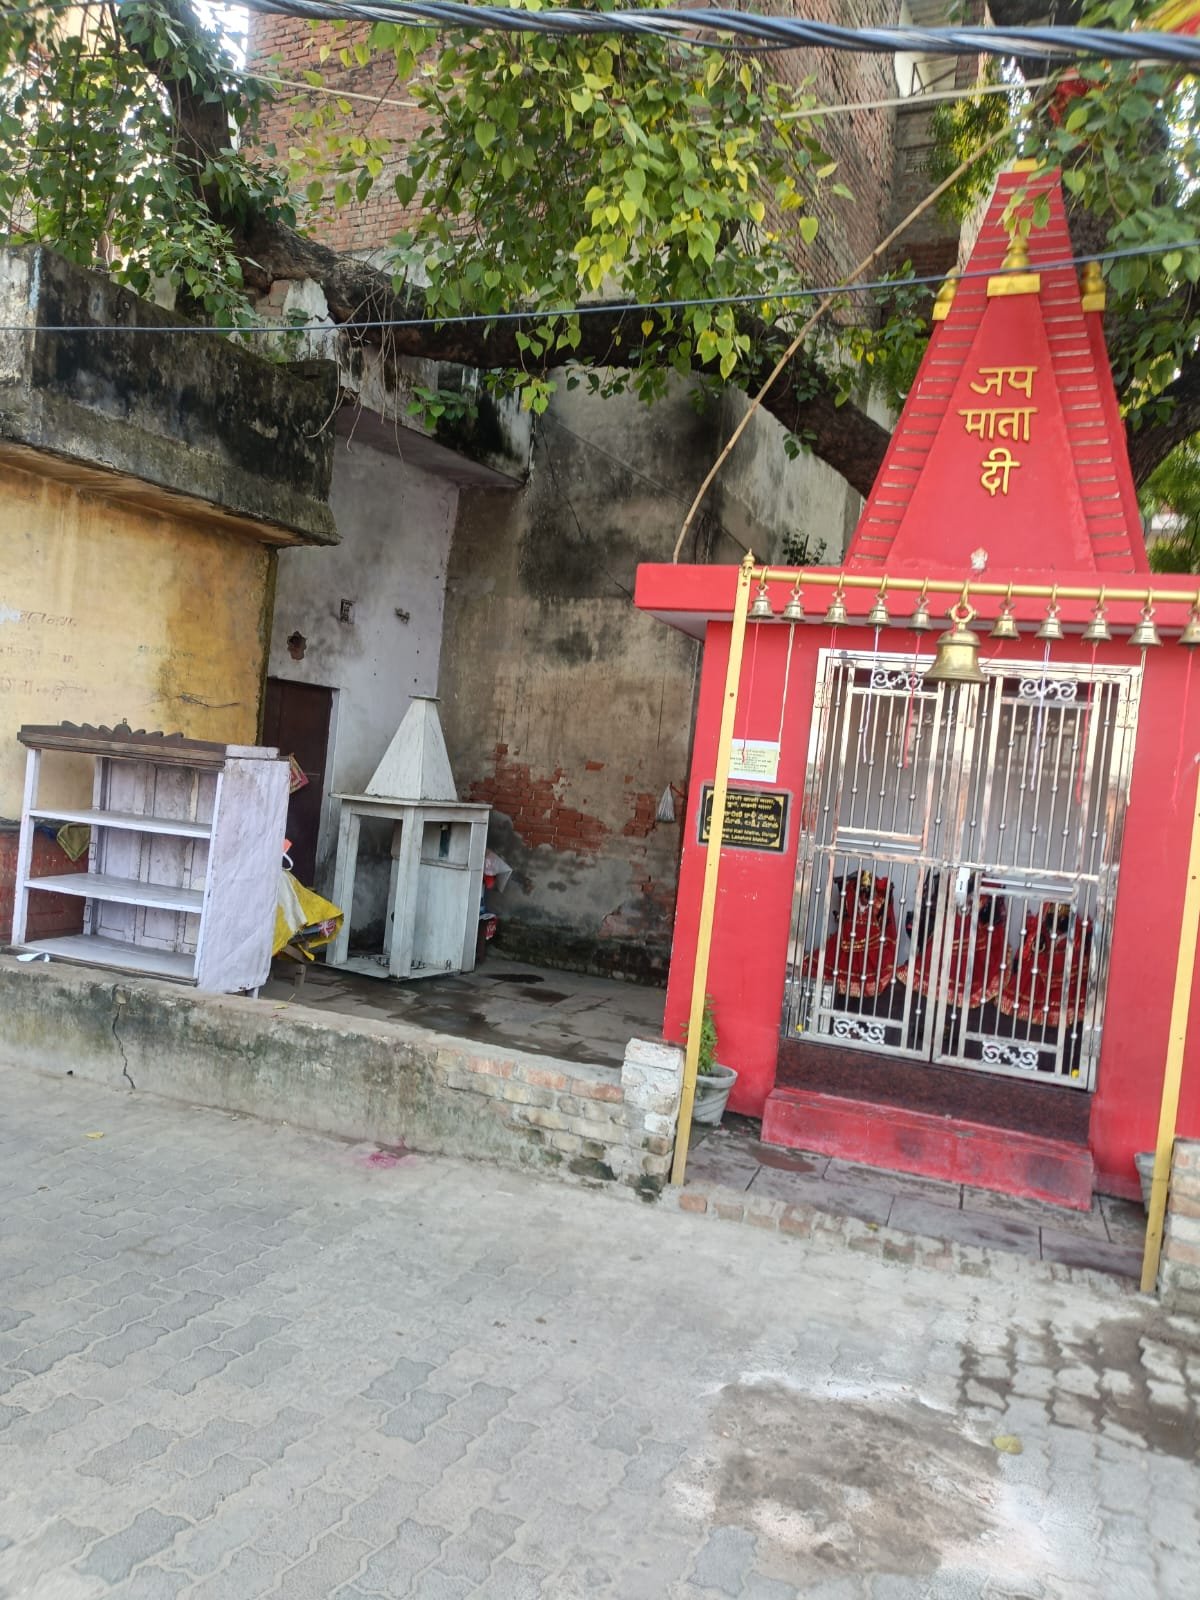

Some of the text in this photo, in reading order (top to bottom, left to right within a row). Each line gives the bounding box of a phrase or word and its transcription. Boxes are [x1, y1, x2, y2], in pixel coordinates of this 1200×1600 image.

[970, 366, 1038, 399] जय
[958, 407, 1038, 442] माता
[981, 447, 1020, 496] दी
